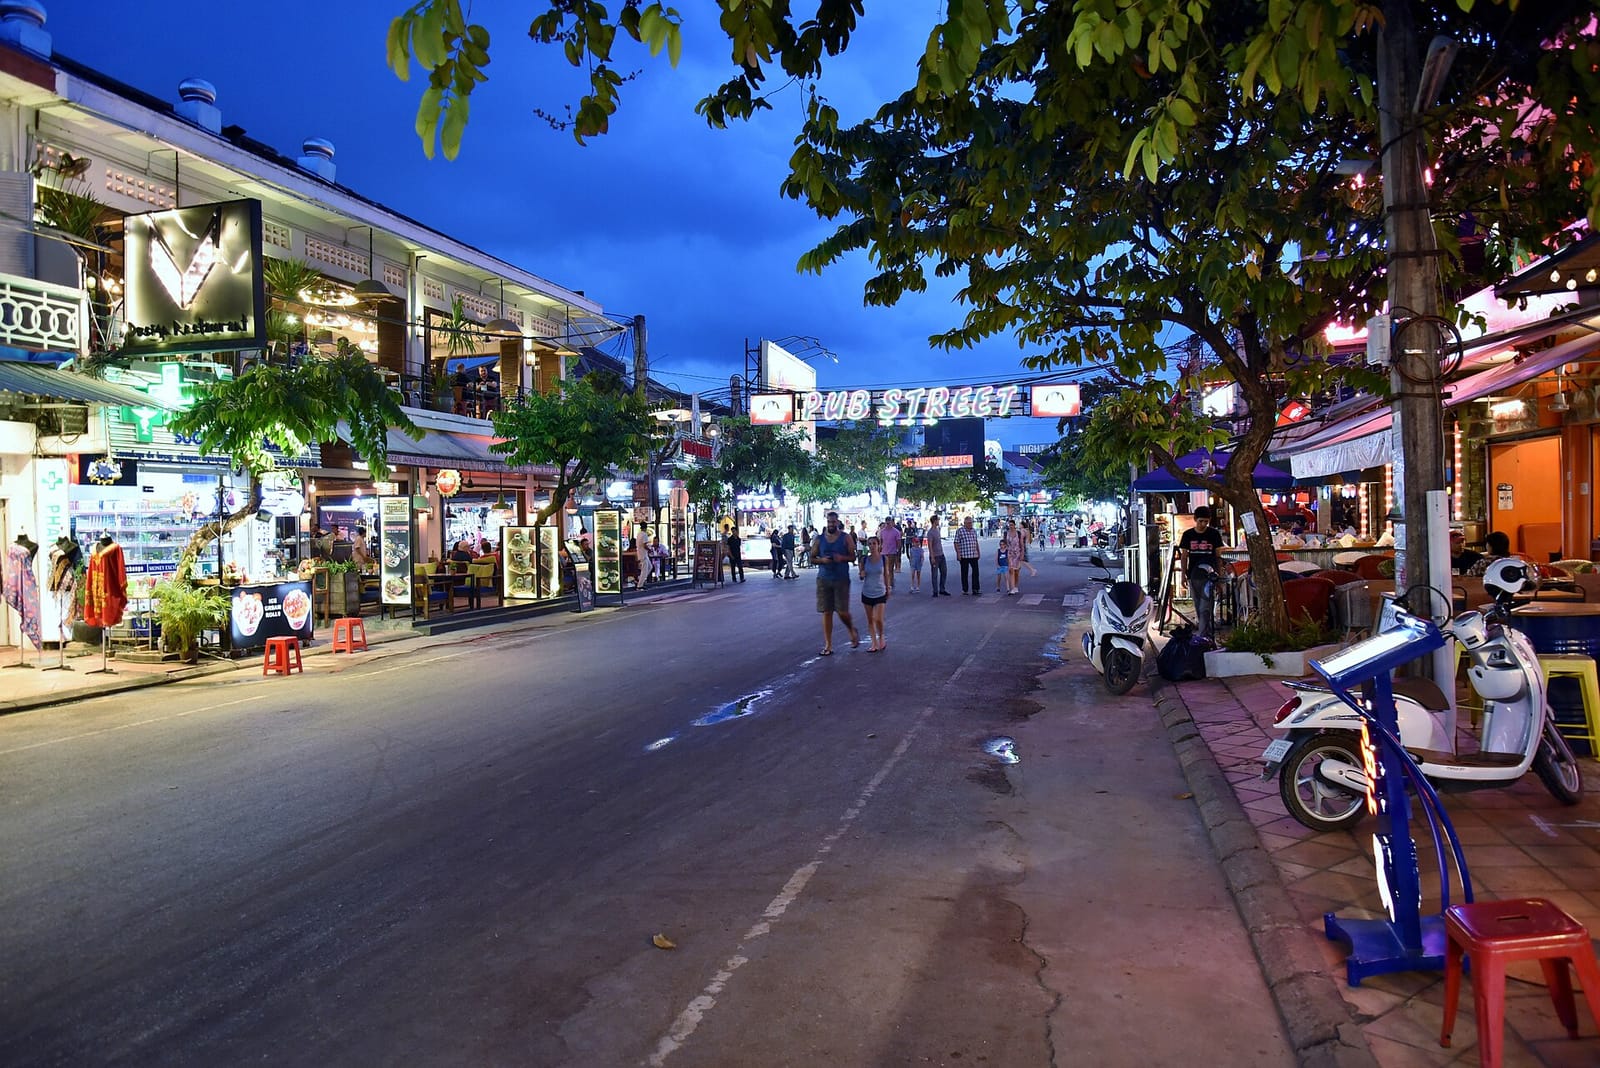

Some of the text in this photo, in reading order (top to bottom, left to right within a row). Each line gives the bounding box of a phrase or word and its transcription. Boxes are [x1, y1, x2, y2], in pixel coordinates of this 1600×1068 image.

[173, 314, 249, 336] Restaurant
[802, 386, 1019, 420] PUB STREET
[914, 456, 944, 467] ANGKOR
